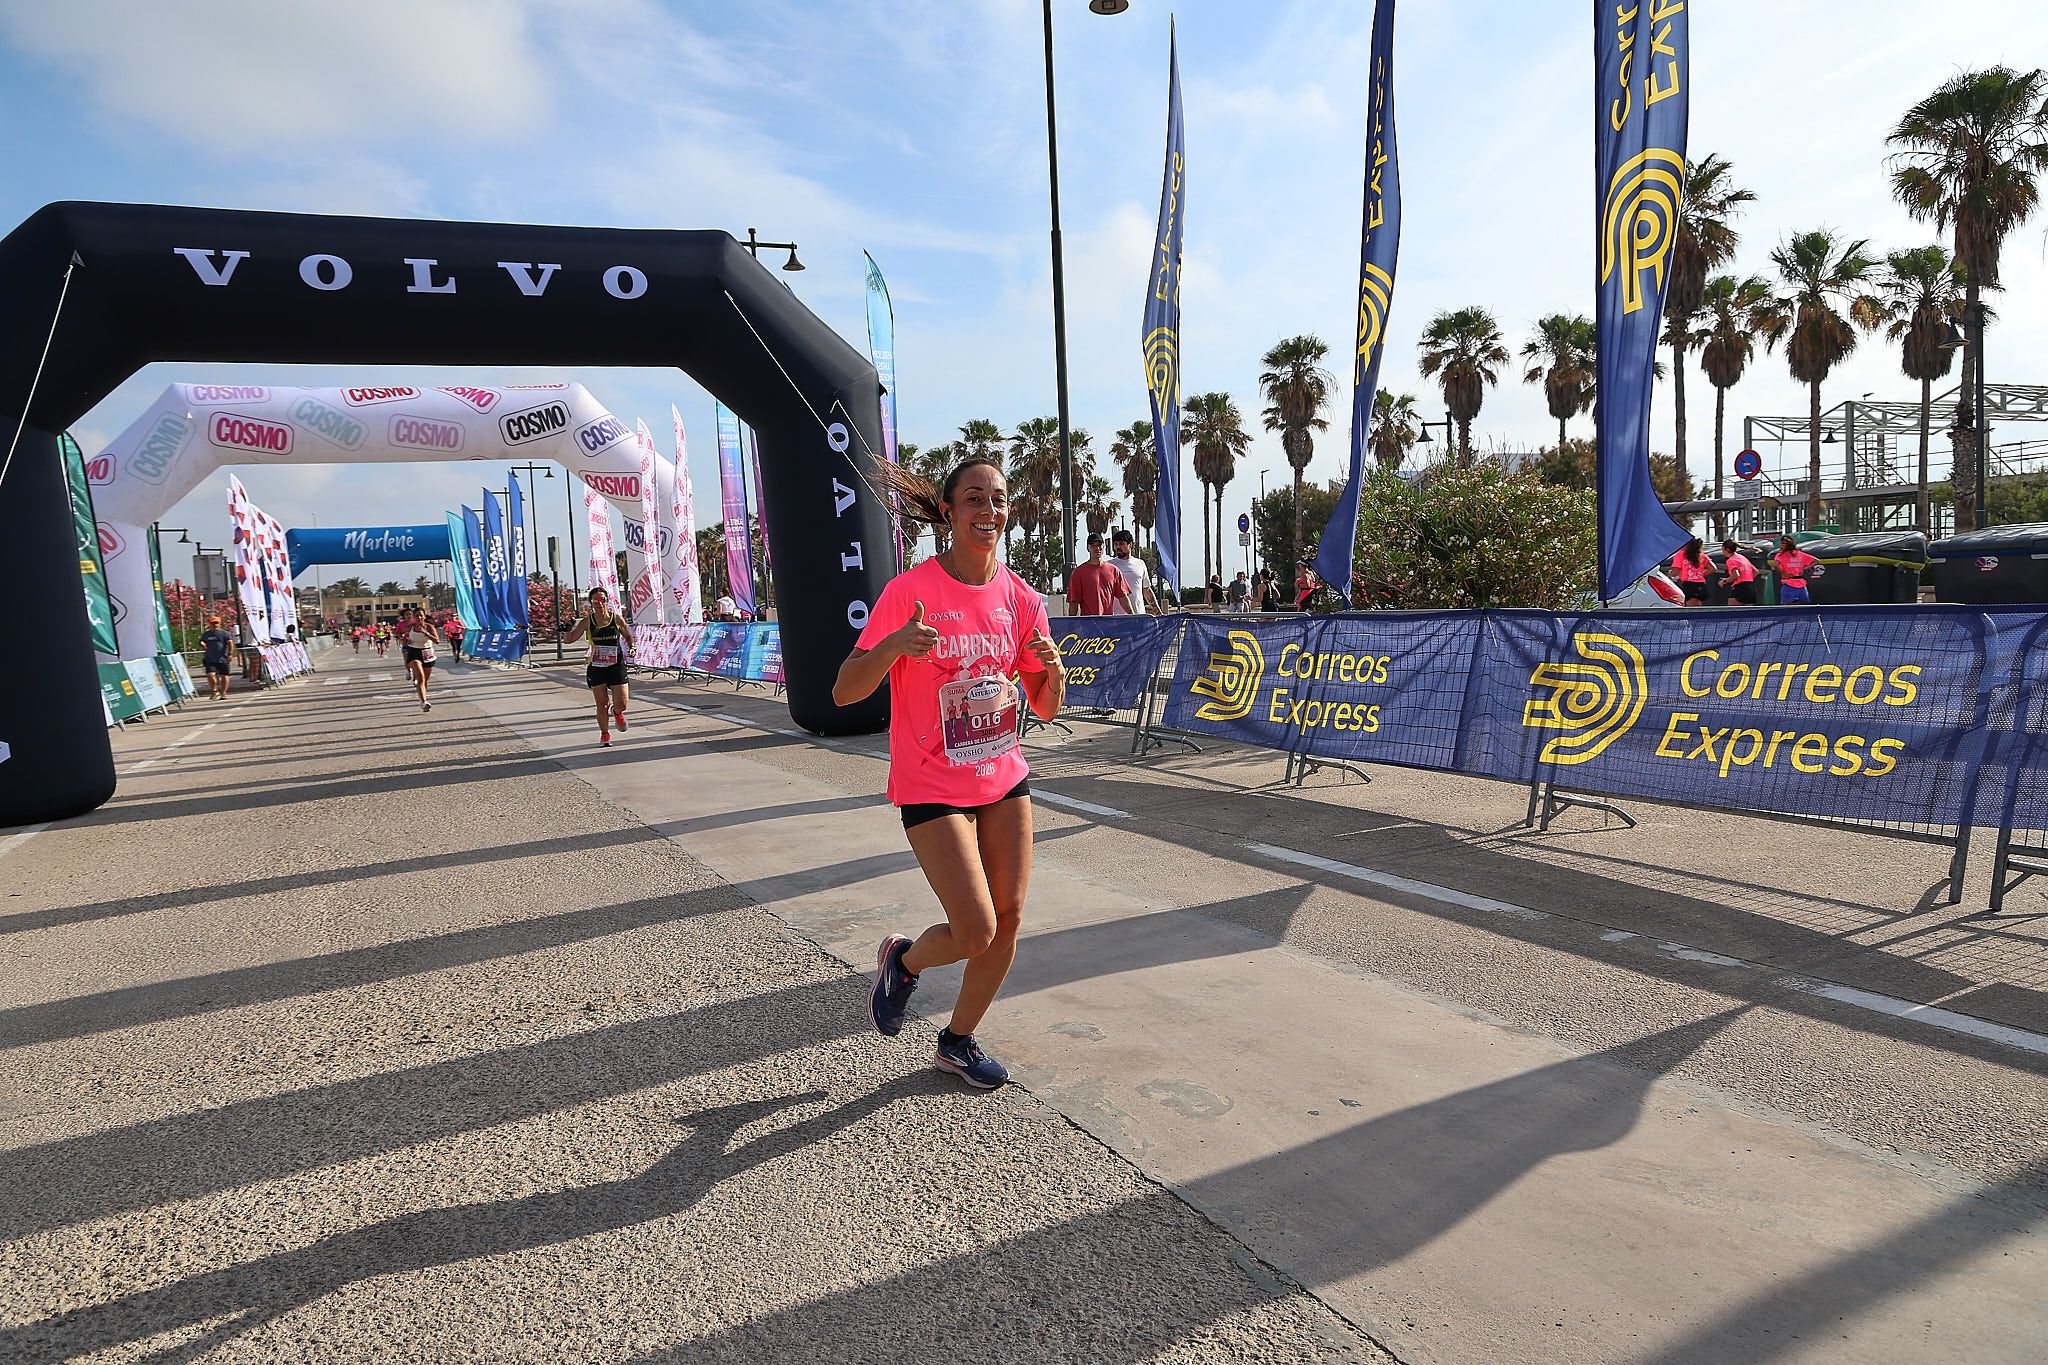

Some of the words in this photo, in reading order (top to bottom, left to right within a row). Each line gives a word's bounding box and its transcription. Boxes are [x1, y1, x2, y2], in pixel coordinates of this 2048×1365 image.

[1612, 4, 1639, 131] Corr
[173, 247, 649, 300] VOLVO
[193, 386, 264, 400] COSMO
[349, 388, 413, 402] COSMO
[436, 387, 494, 408] SMO
[216, 417, 287, 450] COSMO
[295, 400, 361, 446] COSMO
[395, 420, 459, 448] COSMO
[506, 406, 565, 440] COSMO
[133, 418, 184, 477] COSMO
[584, 474, 640, 497] COSMO
[344, 530, 415, 558] Marlene
[928, 610, 964, 622] OYSHO
[936, 633, 1009, 658] CARRERA
[1059, 633, 1121, 656] Correos
[1065, 667, 1101, 685] ress
[1278, 644, 1392, 684] Correos
[1680, 650, 1923, 706] Correos
[1269, 688, 1381, 736] Express
[956, 748, 984, 758] OYSHO
[1655, 712, 1906, 778] Express
[975, 762, 995, 777] 2026
